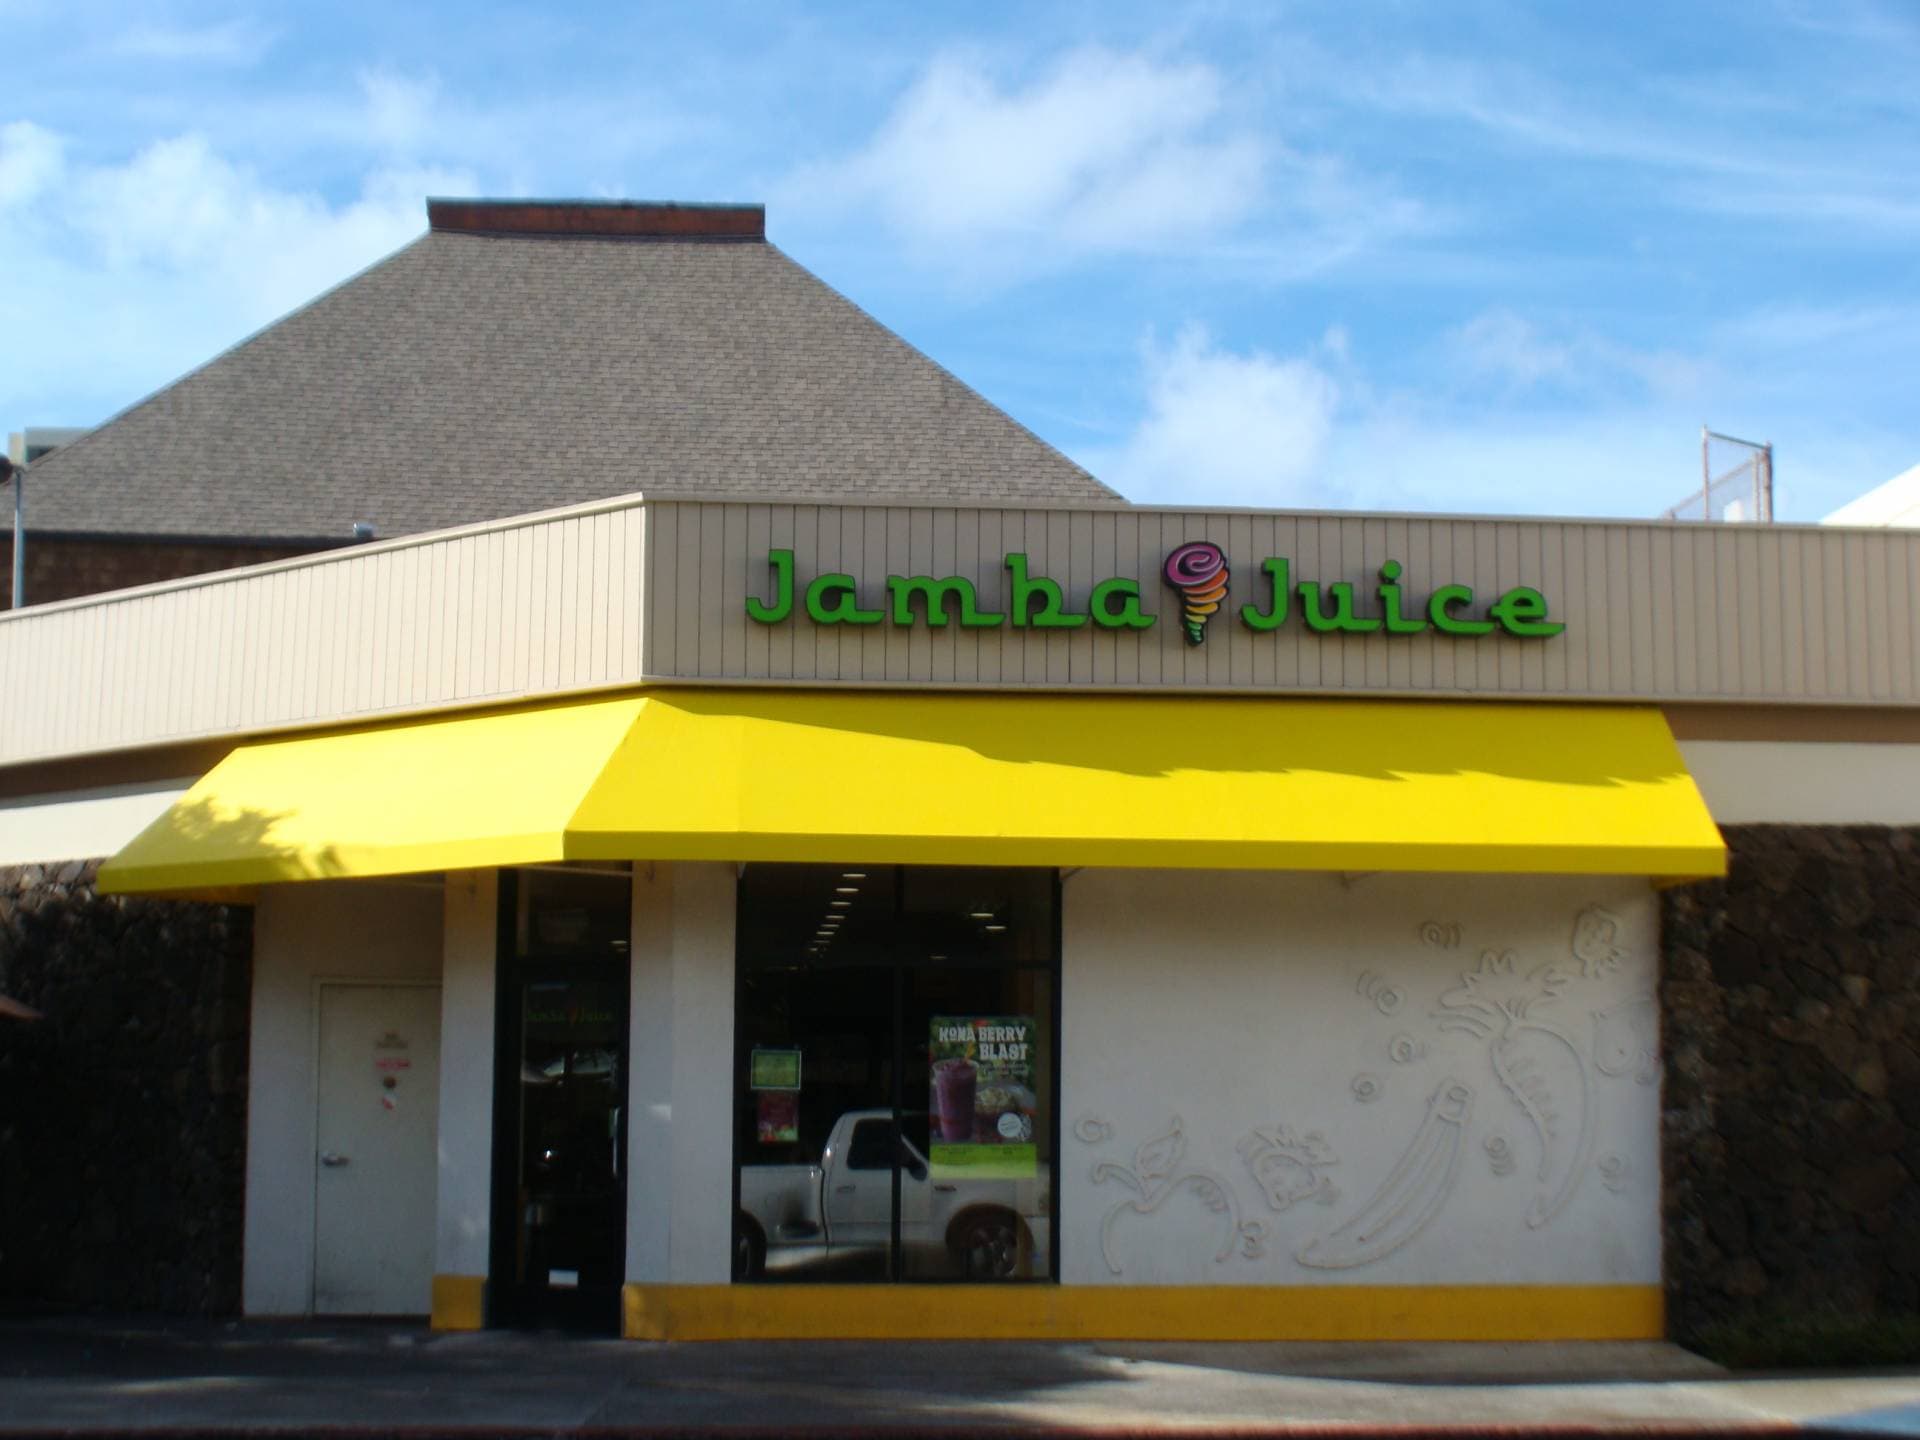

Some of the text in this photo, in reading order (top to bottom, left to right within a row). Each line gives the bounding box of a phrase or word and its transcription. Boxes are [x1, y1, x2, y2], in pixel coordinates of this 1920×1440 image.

[745, 548, 1565, 636] Jamba Juice
[978, 1026, 1027, 1042] BERRY
[979, 1043, 1028, 1060] BLAST
